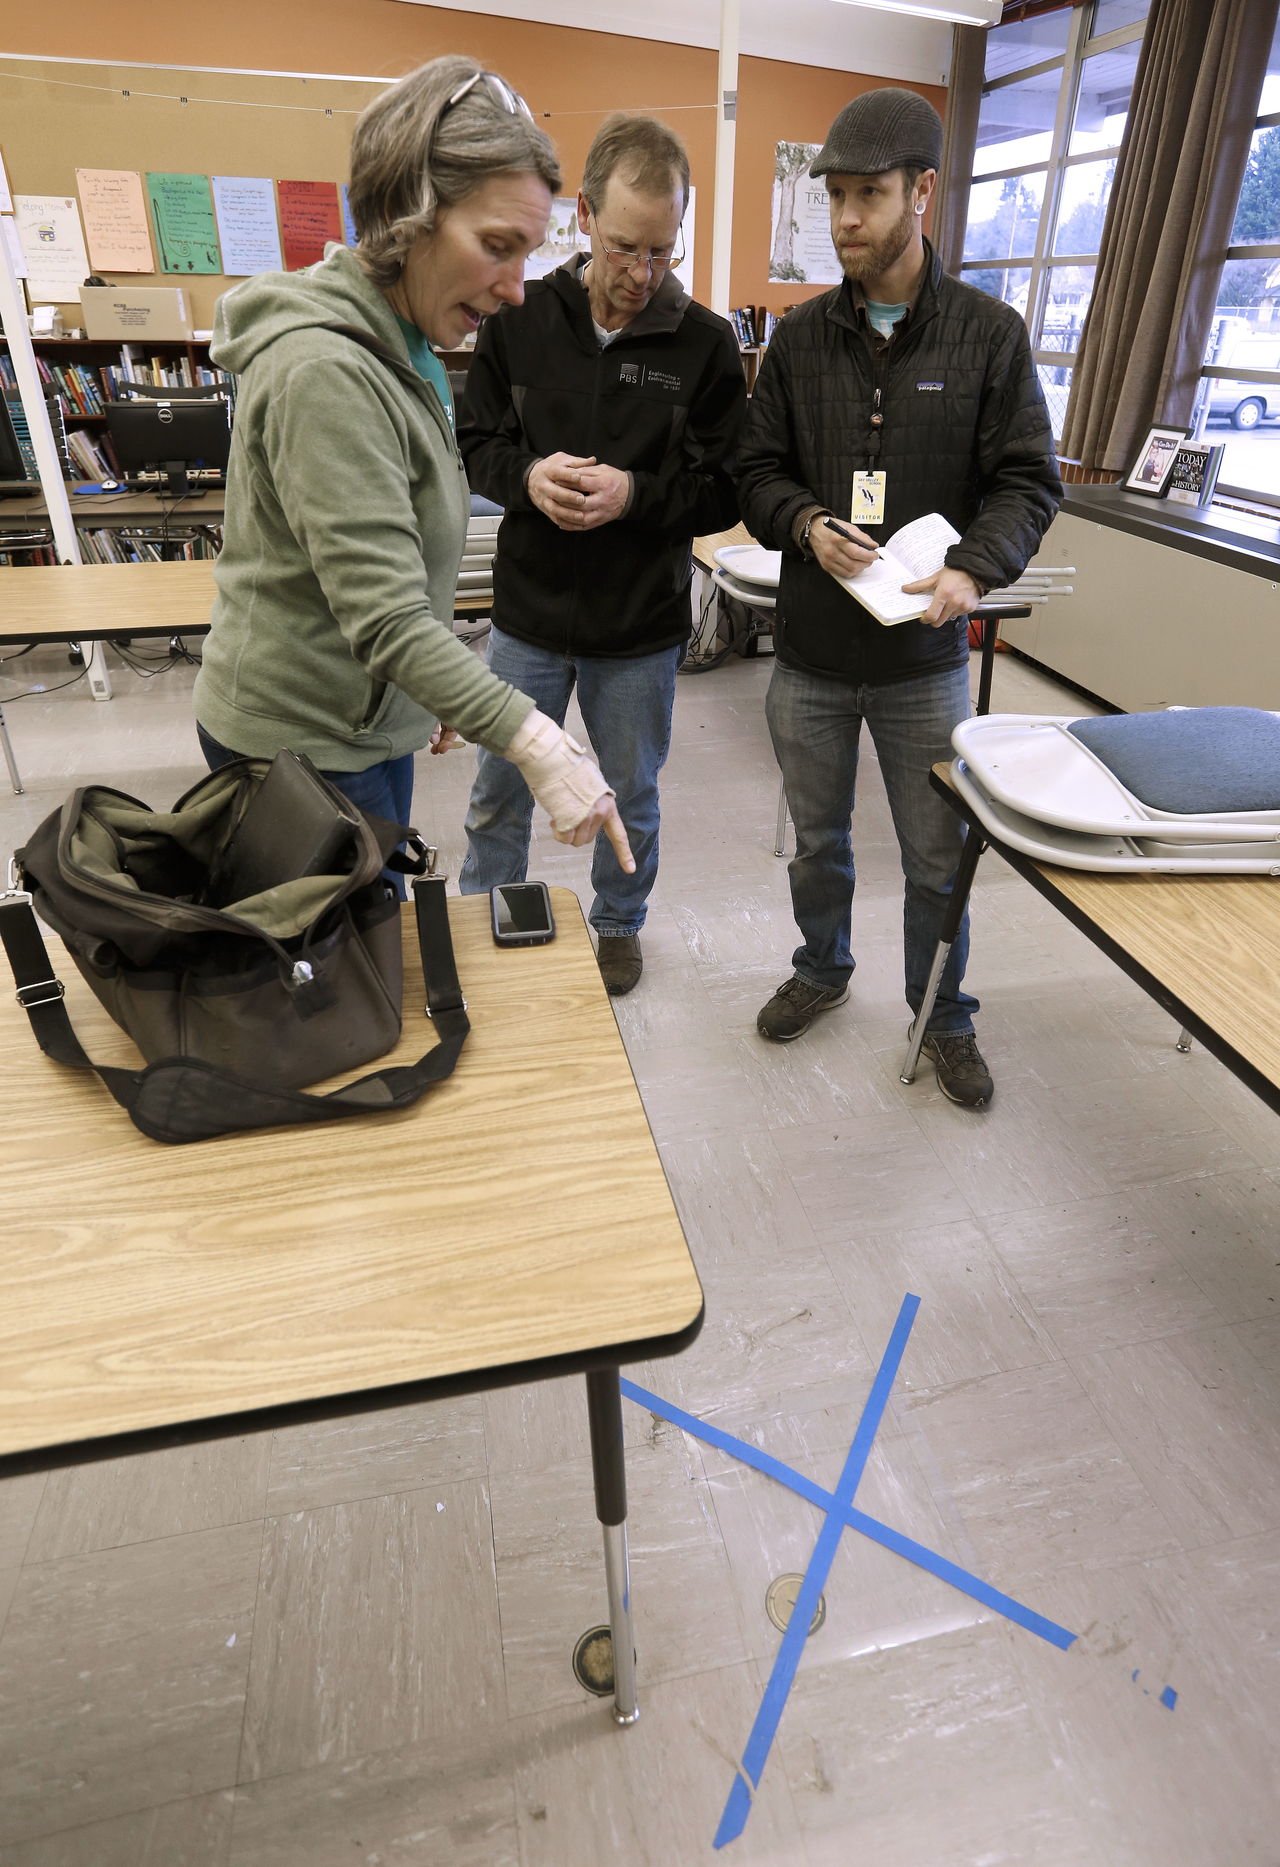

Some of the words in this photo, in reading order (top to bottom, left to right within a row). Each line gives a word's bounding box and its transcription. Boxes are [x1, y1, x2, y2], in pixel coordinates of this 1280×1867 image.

[805, 191, 830, 205] TRE
[619, 373, 638, 384] PBS
[1177, 452, 1207, 469] TODAY
[1174, 480, 1201, 491] HISTORY
